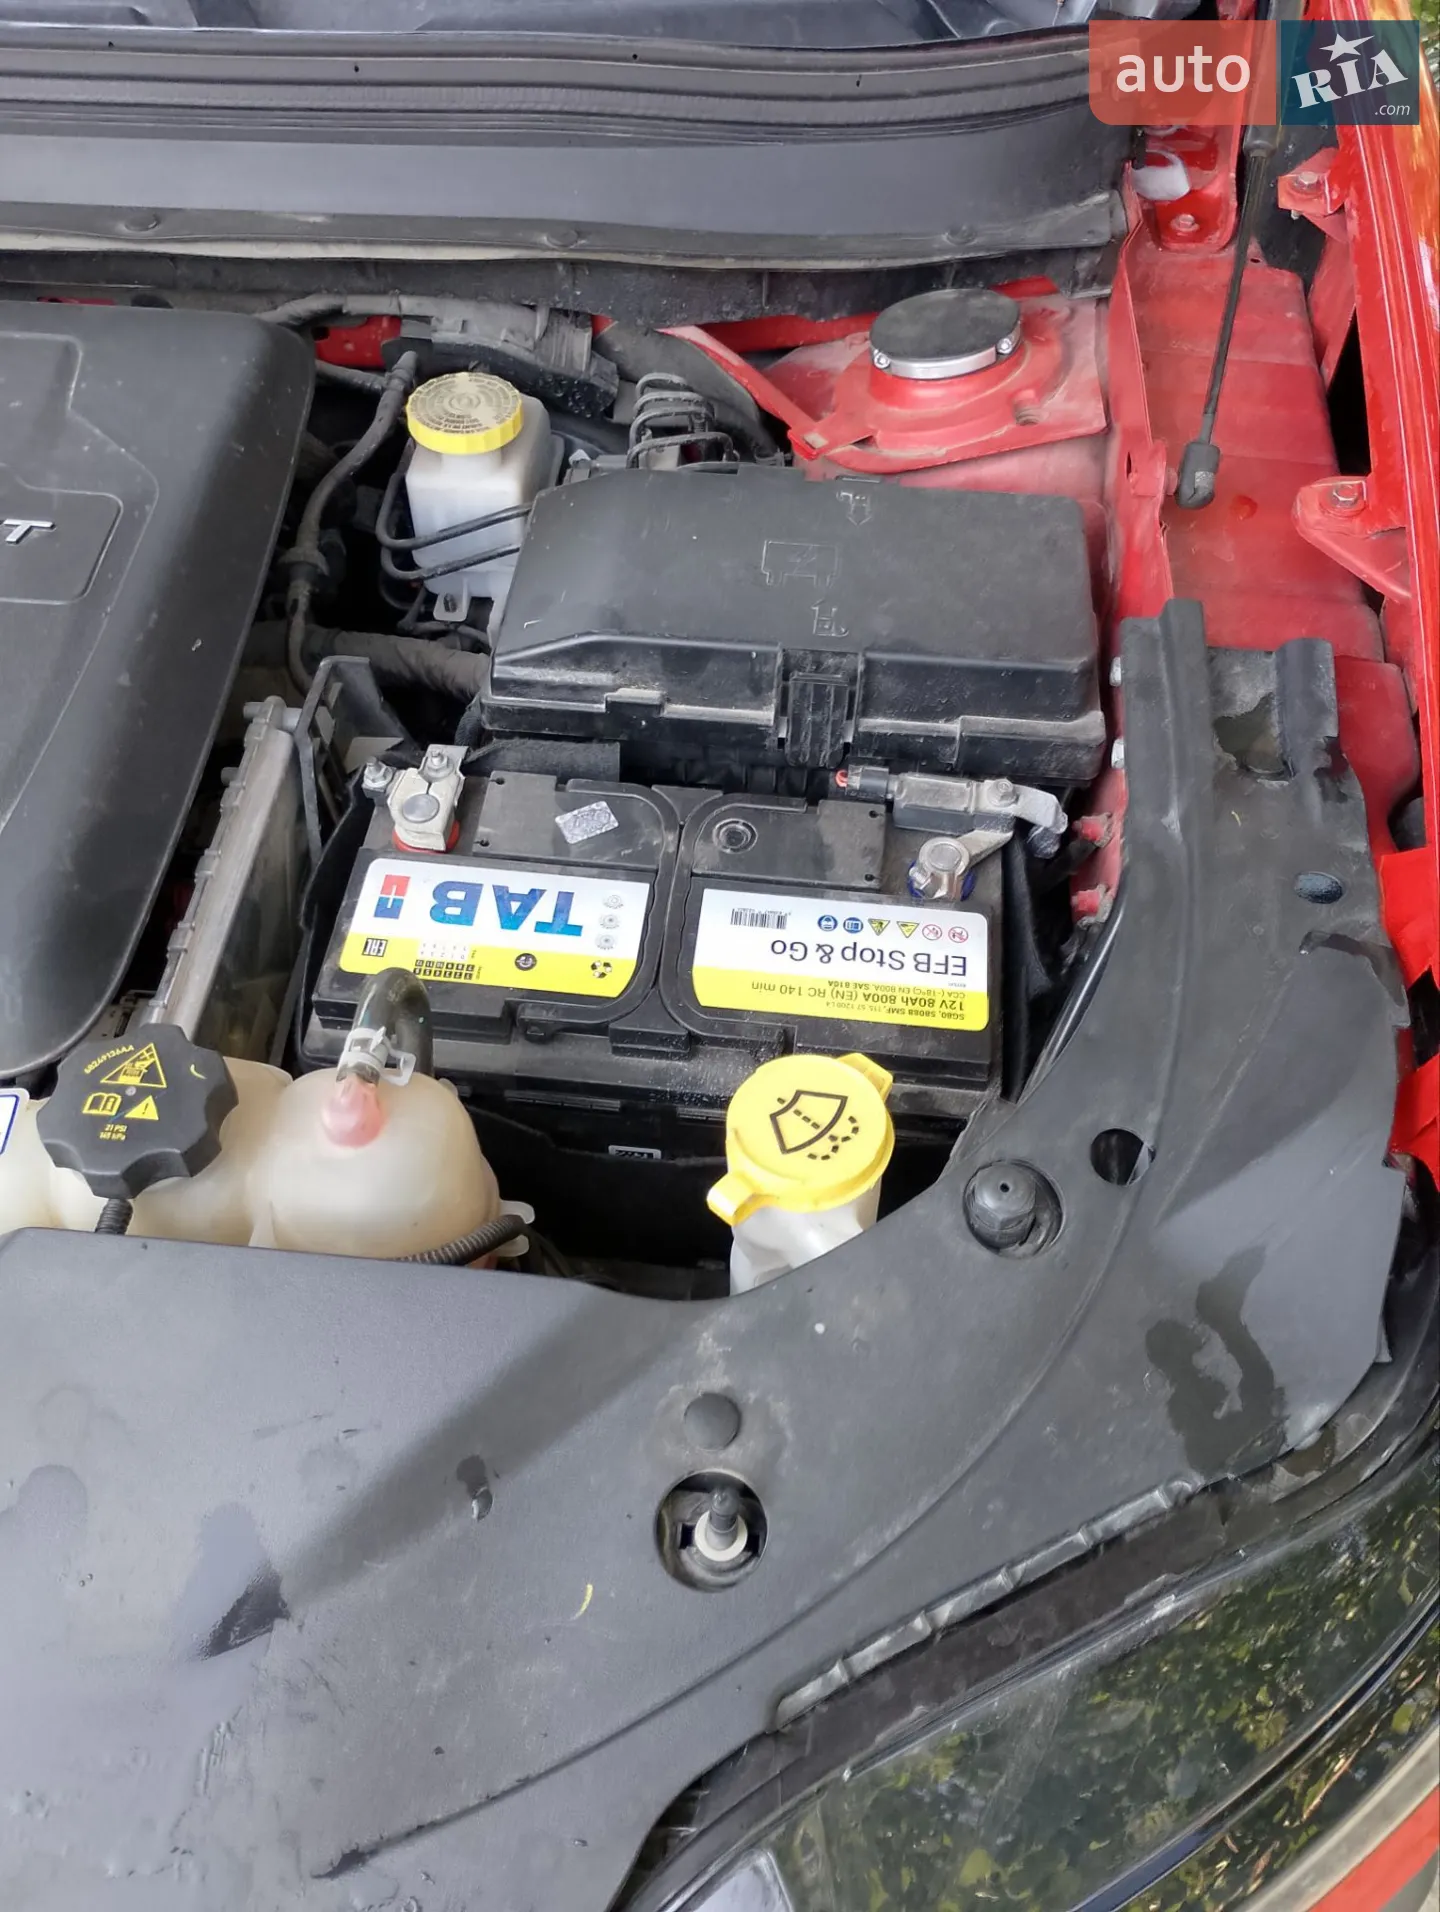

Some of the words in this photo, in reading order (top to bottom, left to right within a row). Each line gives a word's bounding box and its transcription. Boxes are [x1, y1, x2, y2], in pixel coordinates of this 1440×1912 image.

[429, 880, 583, 937] TAB
[770, 939, 809, 962] Go
[815, 943, 835, 965] &
[841, 941, 906, 971] Stop
[913, 952, 968, 977] EFB
[751, 981, 776, 995] min
[780, 984, 803, 997] 140
[827, 979, 851, 990] 810A
[852, 981, 870, 991] SAE
[898, 985, 911, 995] EN
[807, 986, 826, 999] RC
[829, 987, 858, 1002] (EN)
[862, 991, 897, 1005] 800A
[946, 990, 966, 1000] CCA
[901, 995, 935, 1009] 80Ah
[939, 998, 965, 1011] 12V
[113, 1123, 127, 1132] PSI
